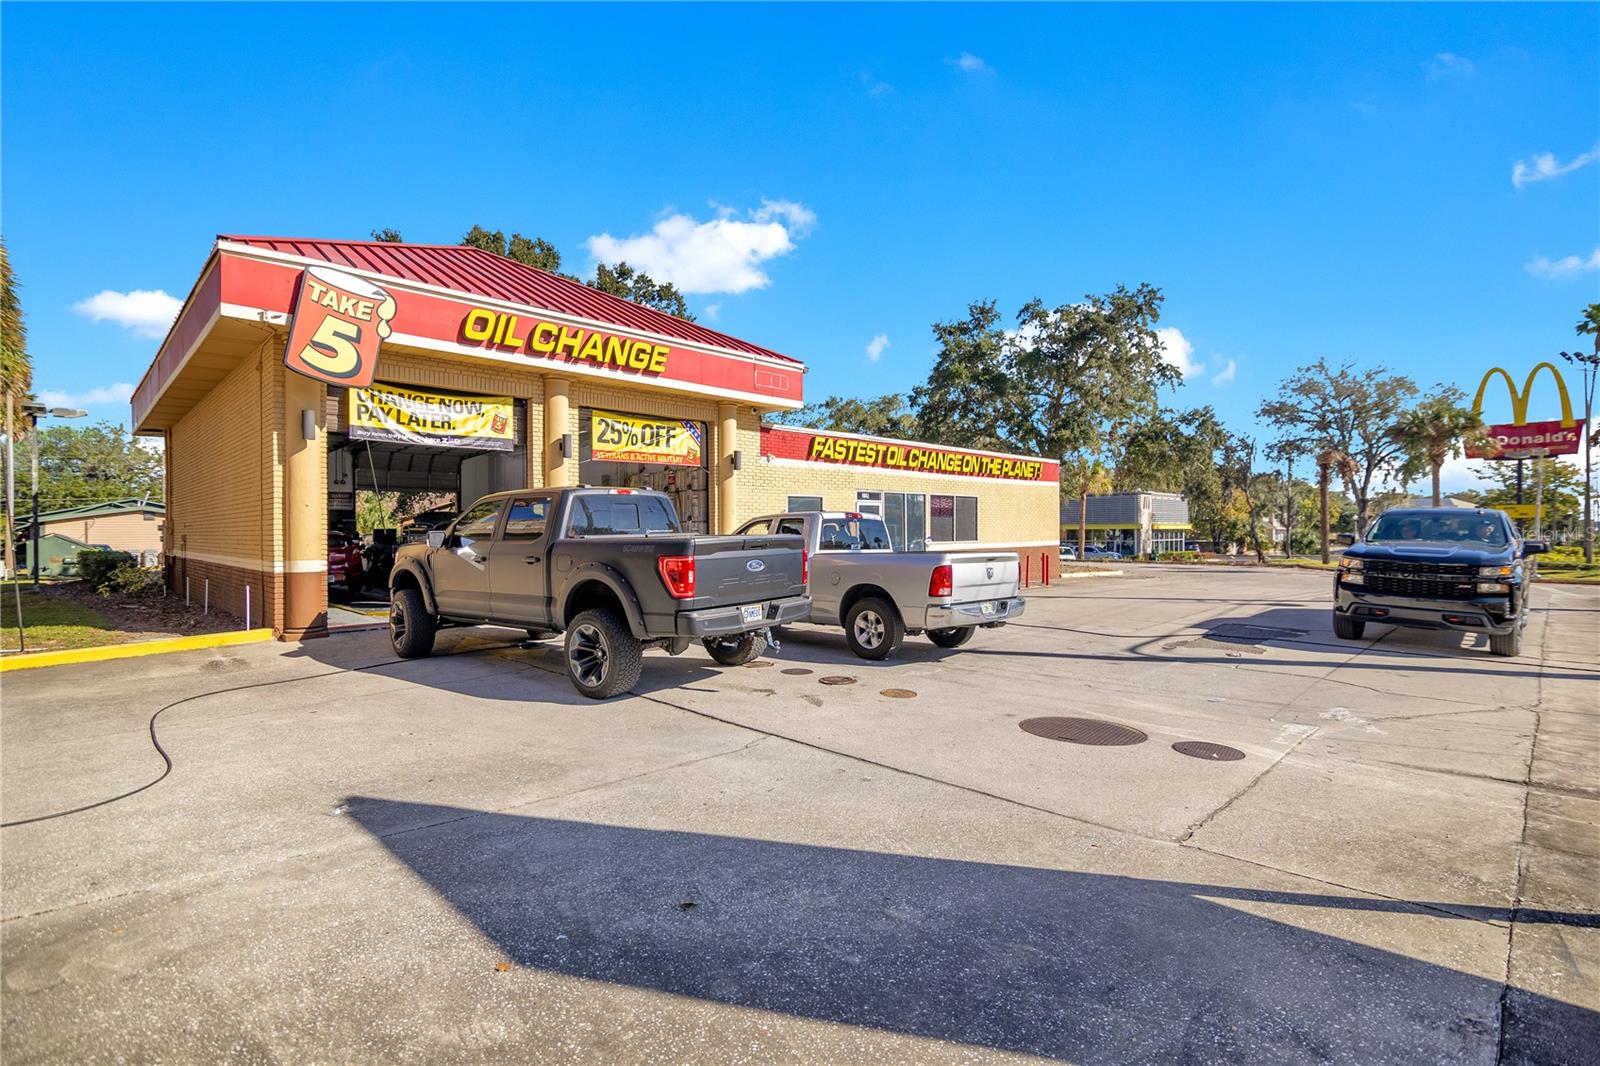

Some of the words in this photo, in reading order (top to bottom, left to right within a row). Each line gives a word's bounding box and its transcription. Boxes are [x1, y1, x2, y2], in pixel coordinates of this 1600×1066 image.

[307, 279, 375, 322] TAKE
[298, 313, 362, 377] 5
[464, 307, 524, 348] OIL
[532, 321, 670, 373] CHANGE
[356, 387, 436, 412] CHANGE
[438, 397, 486, 418] NOW,
[356, 403, 393, 423] PAY
[395, 407, 456, 430] LATER.
[356, 429, 371, 437] Buy
[596, 418, 638, 447] 25%
[641, 423, 677, 448] OFF
[594, 451, 629, 460] VETERANS
[630, 452, 635, 460] &
[636, 453, 656, 462] ACTIVE
[657, 454, 684, 463] MILITARY
[812, 435, 887, 464] FASTEST
[886, 444, 908, 467] OIL
[908, 448, 962, 472] CHANGE
[962, 455, 980, 473] ON
[981, 456, 1003, 475] THE
[1002, 459, 1044, 478] PLANET!
